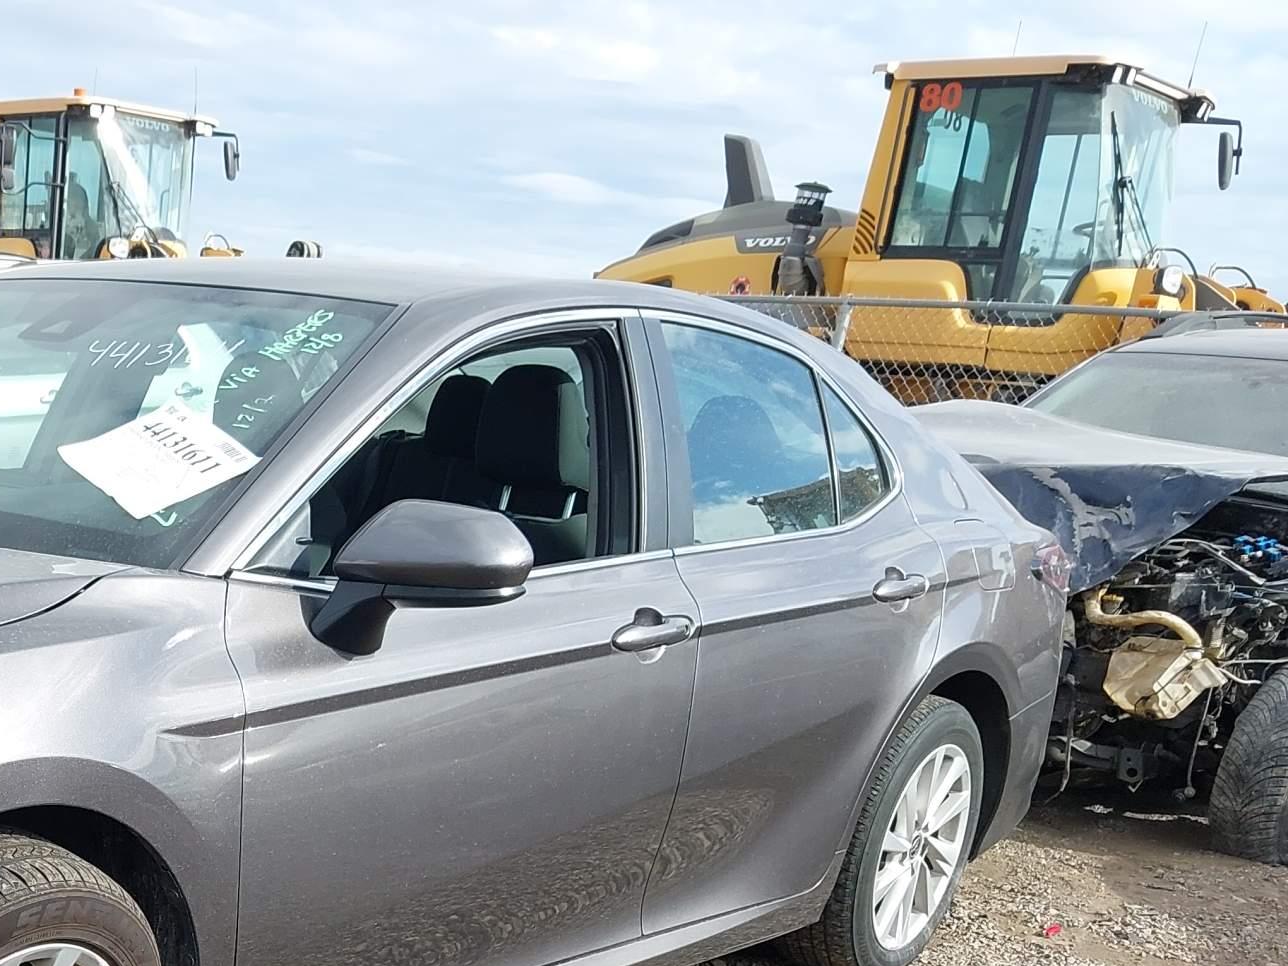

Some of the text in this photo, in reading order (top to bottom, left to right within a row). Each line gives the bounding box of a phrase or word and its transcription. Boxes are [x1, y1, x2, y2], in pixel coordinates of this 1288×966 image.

[919, 82, 963, 112] 80
[1131, 89, 1169, 114] VOLVO
[125, 116, 171, 133] VOLVO
[744, 235, 817, 248] VOL
[142, 422, 222, 474] 44131611
